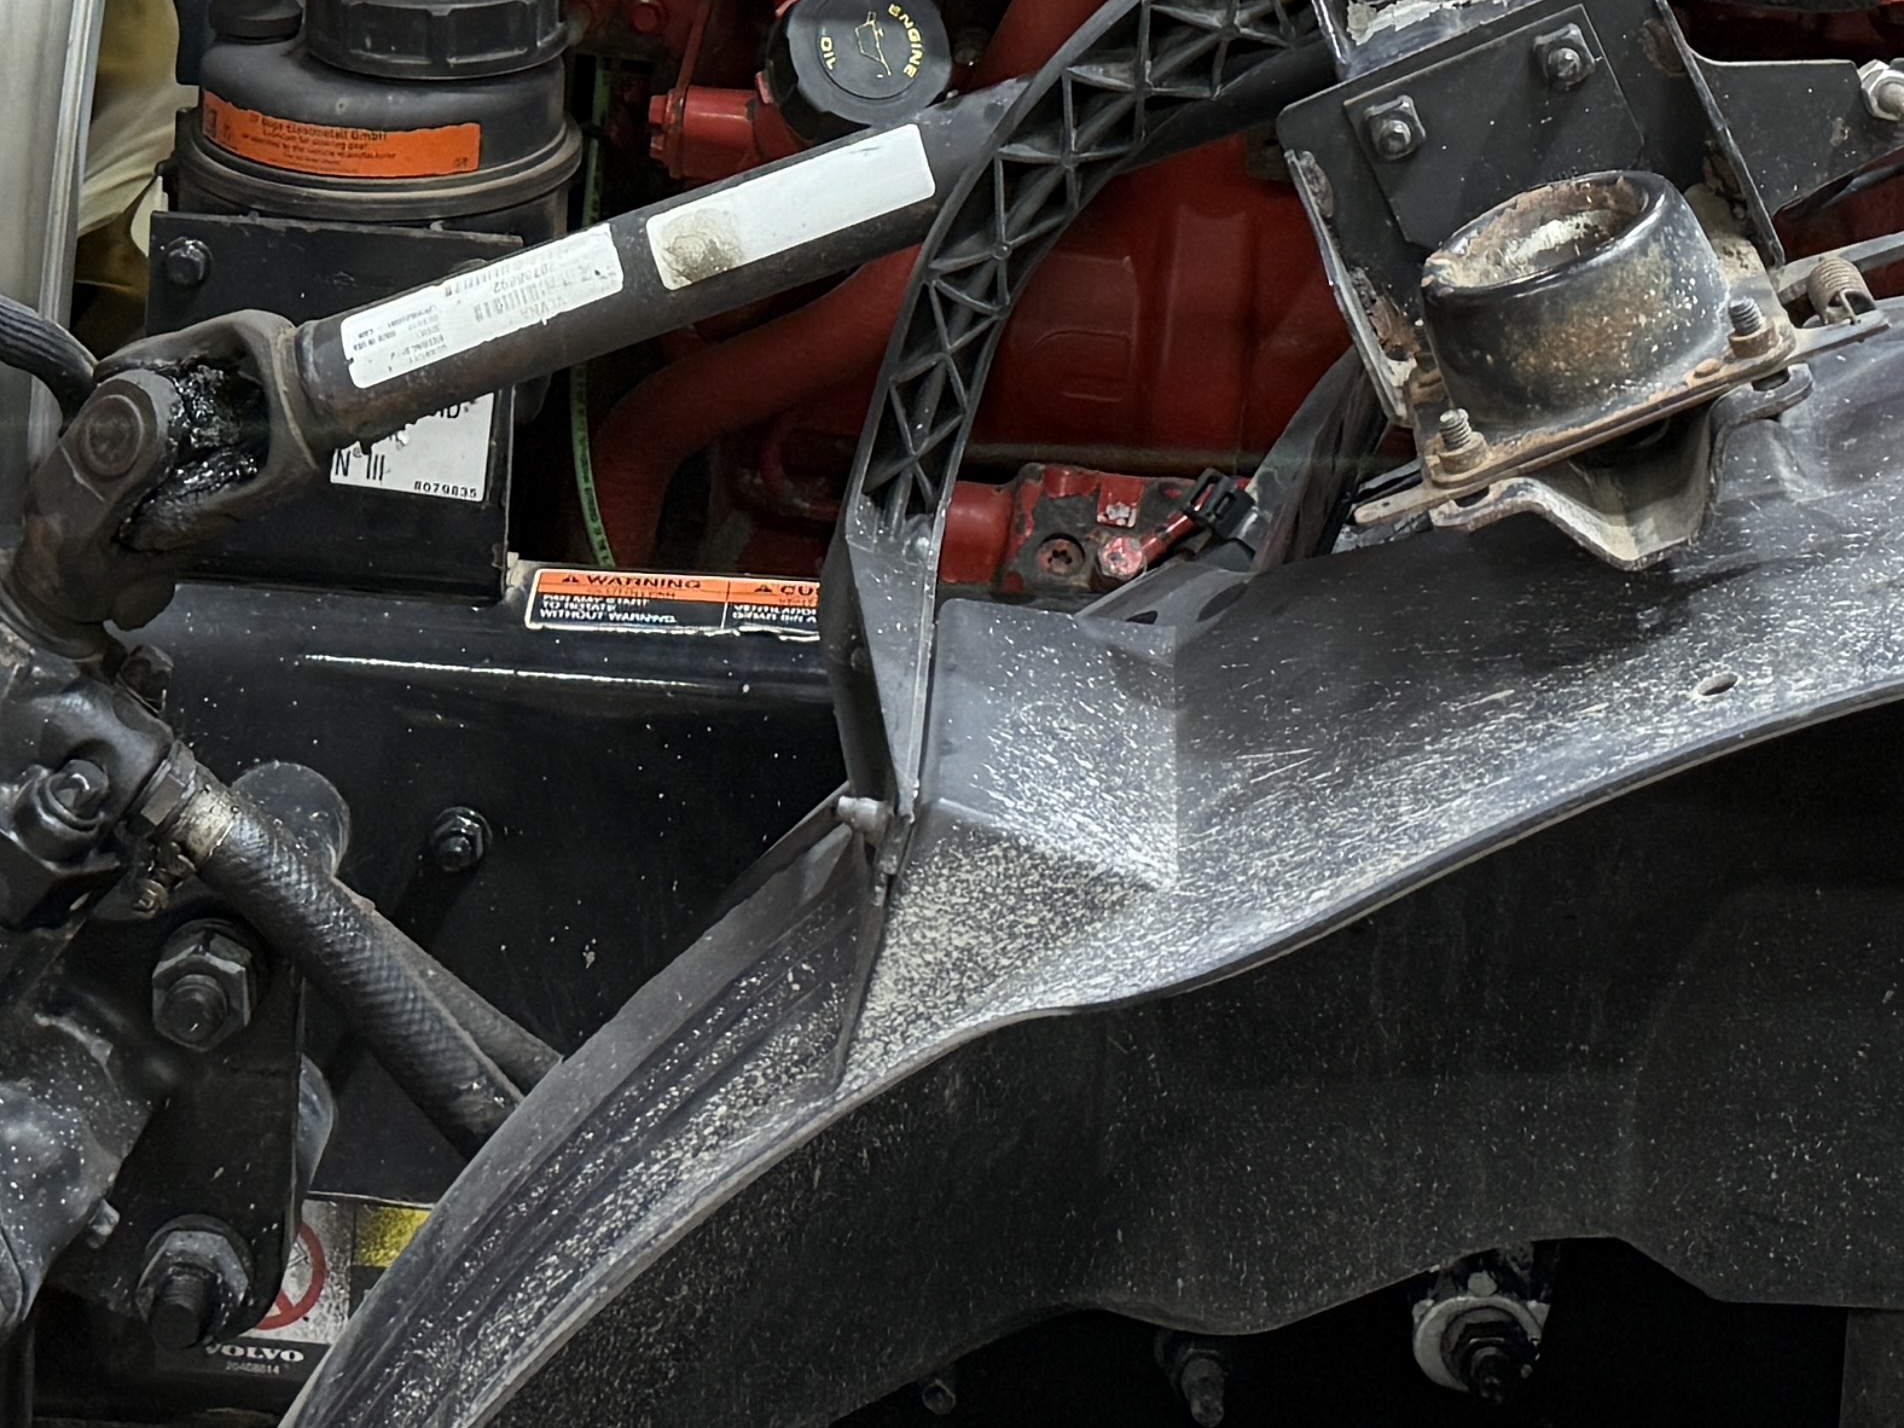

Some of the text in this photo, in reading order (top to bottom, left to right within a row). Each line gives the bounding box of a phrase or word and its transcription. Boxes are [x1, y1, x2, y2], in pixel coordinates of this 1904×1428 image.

[888, 3, 924, 78] ENGINE
[820, 36, 837, 71] OIL
[586, 575, 701, 589] WARNING
[539, 608, 604, 621] WITHOUT
